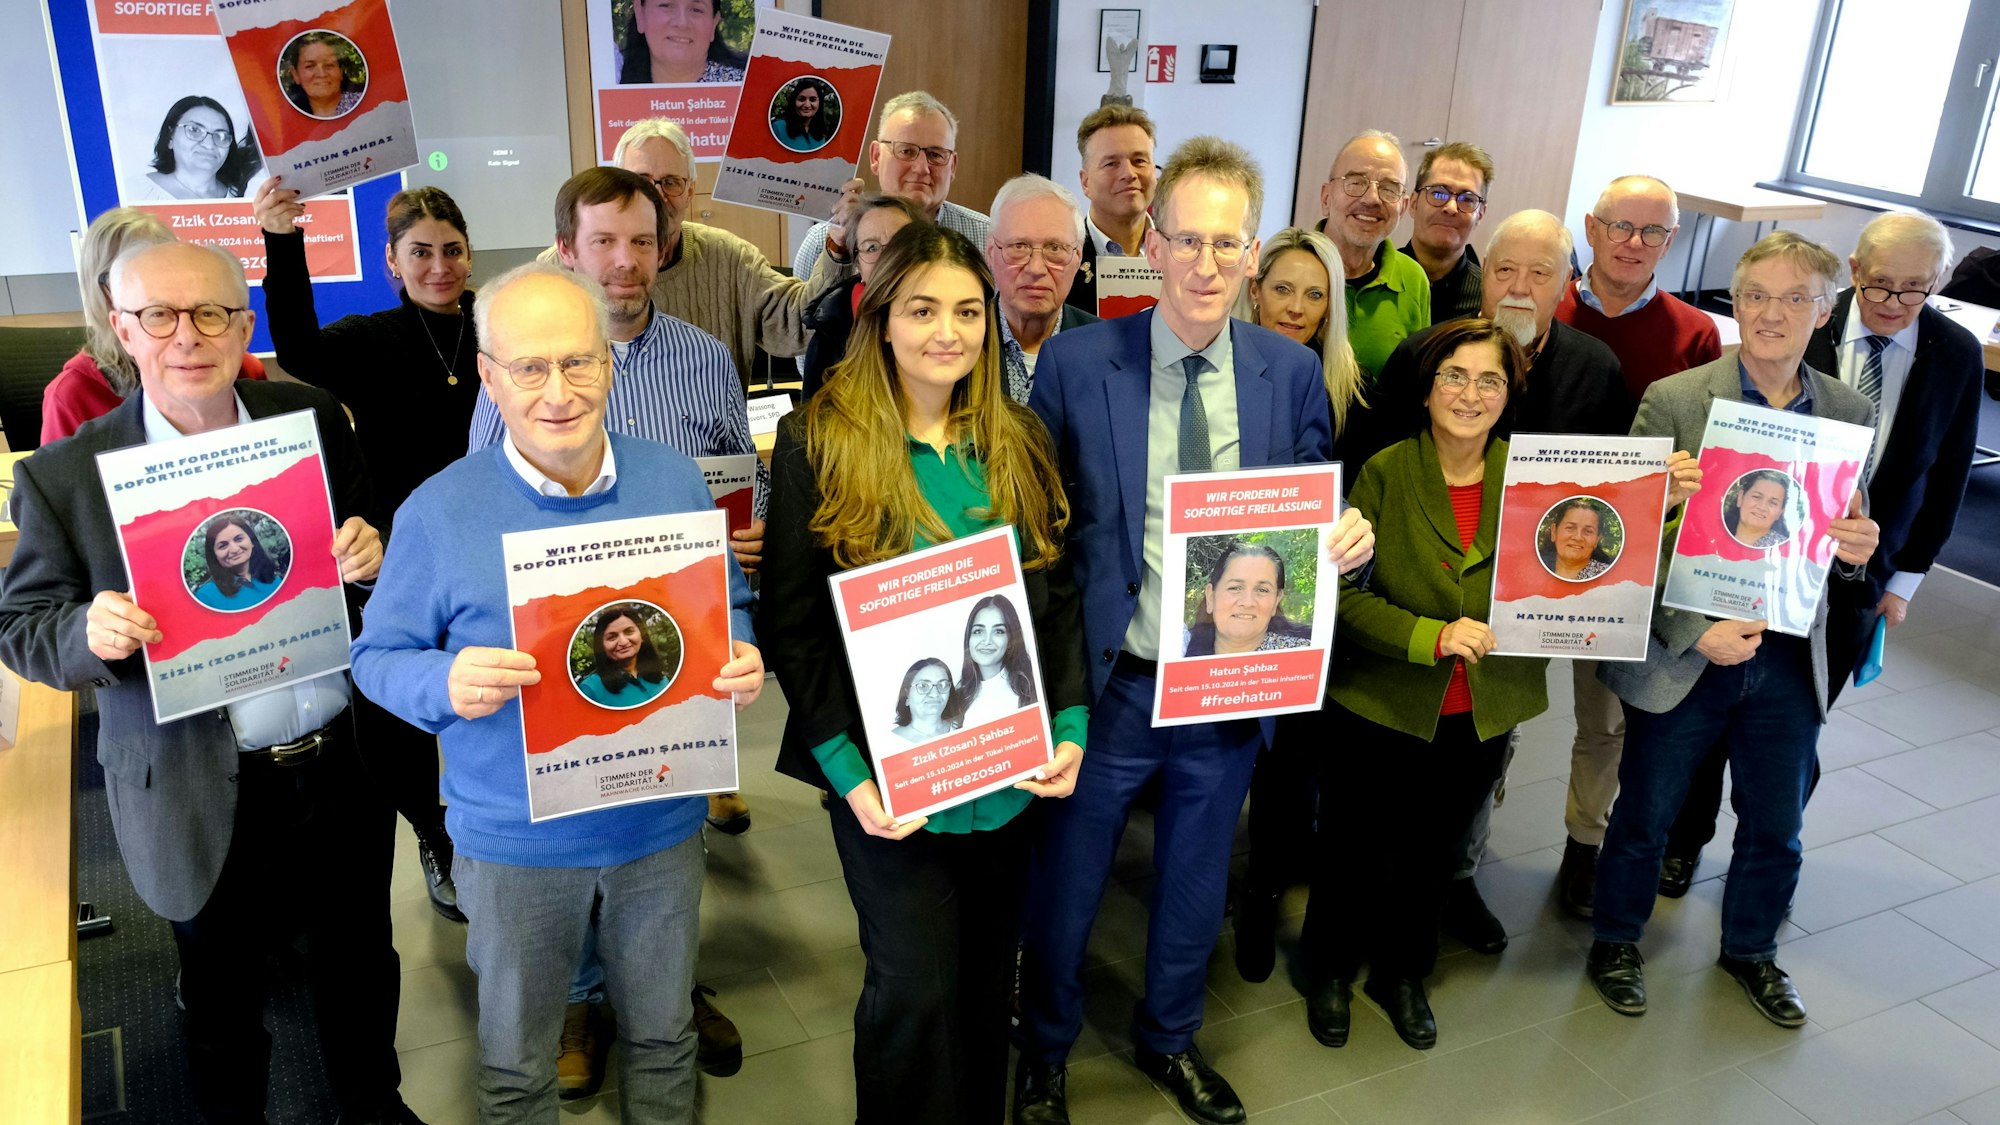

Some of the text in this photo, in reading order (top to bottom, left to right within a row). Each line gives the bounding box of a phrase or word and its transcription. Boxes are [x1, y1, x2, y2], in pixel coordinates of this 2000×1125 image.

[114, 2, 202, 16] SOFORTIGE
[760, 28, 883, 59] SOFORTIGE FREILASSUNG!
[782, 25, 864, 48] WIR FORDERN DIE
[650, 98, 726, 112] Hatun Şahbaz
[293, 135, 394, 170] HATUN ŞAHBAZ
[757, 172, 801, 186] (ZOSAN)
[171, 213, 207, 228] Zizik
[243, 236, 253, 246] in
[254, 236, 266, 246] de
[768, 411, 780, 419] SPD
[1737, 417, 1759, 427] WIR
[1713, 420, 1775, 438] SOFORTIGE
[113, 440, 312, 492] SOFORTIGE FREILASSUNG!
[144, 438, 279, 475] WIR FORDERN DIE
[1512, 456, 1578, 464] SOFORTIGE
[1206, 487, 1299, 503] WIR FORDERN DIE
[1184, 499, 1322, 519] SOFORTIGE FREILASSUNG!
[546, 533, 685, 558] WIR FORDERN DIE
[513, 539, 720, 572] SOFORTIGE FREILASSUNG!
[878, 557, 974, 593] WIR FORDERN DIE
[1693, 568, 1737, 583] HATUN
[859, 564, 1001, 614] SOFORTIGE FREILASSUNG!
[1516, 613, 1624, 624] HATUN ŞAHBAZ
[208, 642, 275, 668] (ZOSAN)
[279, 622, 342, 648] ŞAHBAZ
[224, 661, 275, 681] STIMMEN DER
[225, 669, 275, 688] SOLIDARITÄT
[1209, 663, 1279, 677] Hatun Şahbaz
[1184, 684, 1199, 692] dem
[1201, 680, 1238, 691] 15.10.2024
[1239, 679, 1247, 687] in
[1247, 678, 1259, 686] der
[1280, 673, 1315, 683] inhaftiert!
[1200, 690, 1282, 708] #freehatun
[585, 746, 655, 766] (ZOSAN)
[659, 738, 729, 755] ŞAHBAZ
[911, 725, 1016, 767] Zizik (Zosan) Şahbaz
[894, 780, 909, 790] Seit
[909, 774, 925, 785] dem
[926, 761, 965, 779] 15.10.2024
[973, 754, 984, 763] der
[985, 747, 1003, 758] Tükei
[1004, 734, 1039, 752] inhaftiert!
[600, 768, 654, 784] STIMMEN DER
[600, 776, 652, 792] SOLIDARITÄT
[930, 759, 1012, 796] #freezosan
[600, 787, 640, 798] MAHNWACHE
[641, 783, 658, 792] KÖLN
